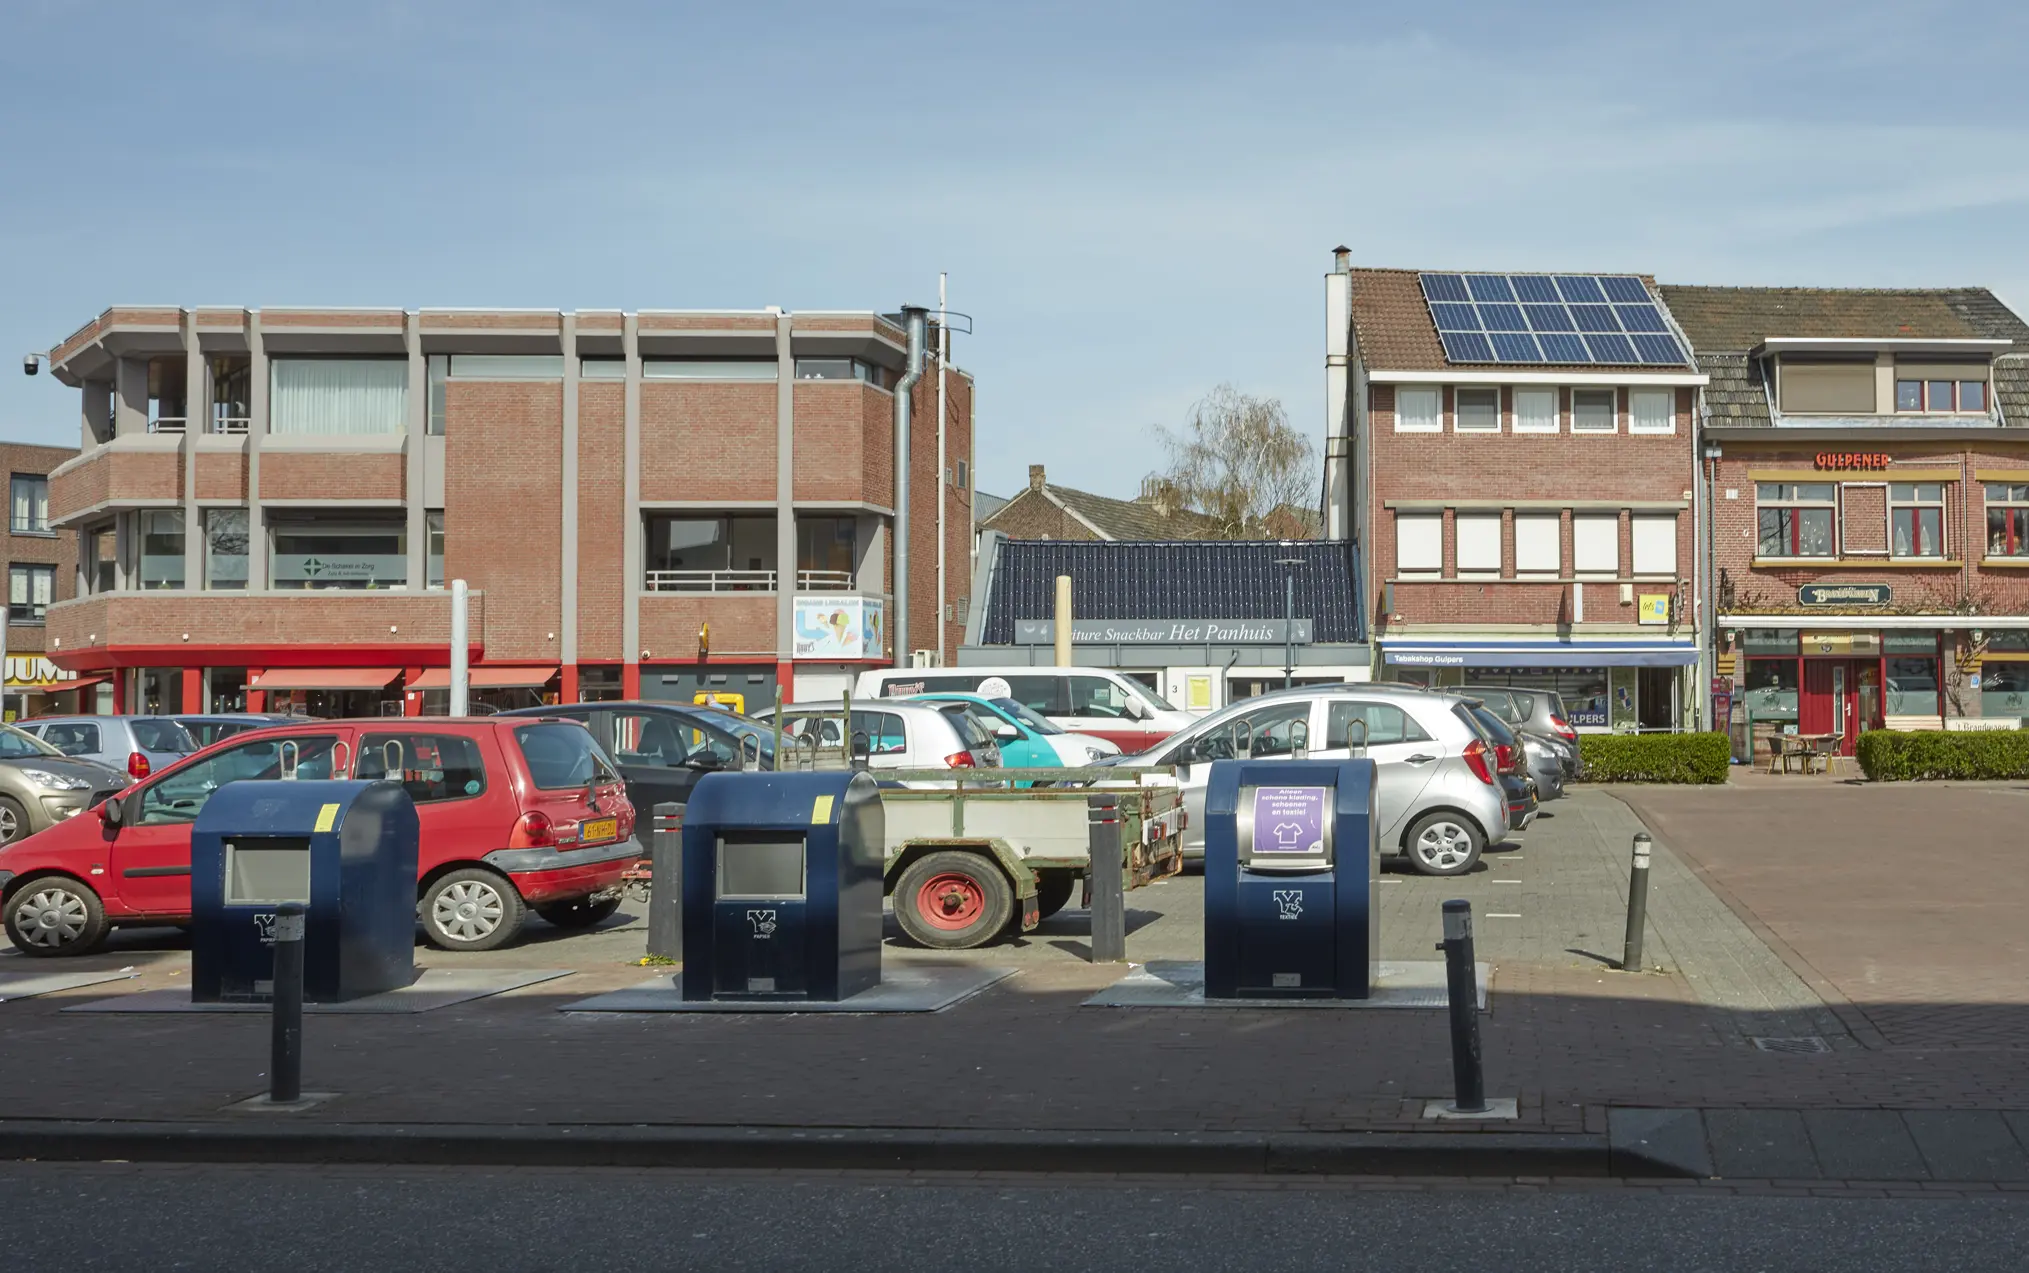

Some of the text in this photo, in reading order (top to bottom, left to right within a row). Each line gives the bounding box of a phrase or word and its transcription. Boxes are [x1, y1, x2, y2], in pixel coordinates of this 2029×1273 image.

[1816, 452, 1889, 467] GULPENER
[361, 562, 375, 572] Zorg
[1071, 623, 1275, 641] iture Snackbar Het Panhuis
[1394, 655, 1464, 664] Tabakshop Gulpers
[1172, 684, 1178, 694] 3
[1569, 714, 1605, 724] LPERS
[1963, 722, 2011, 732] Brandwagen
[1271, 800, 1307, 808] schoenen
[1282, 808, 1306, 816] textiel
